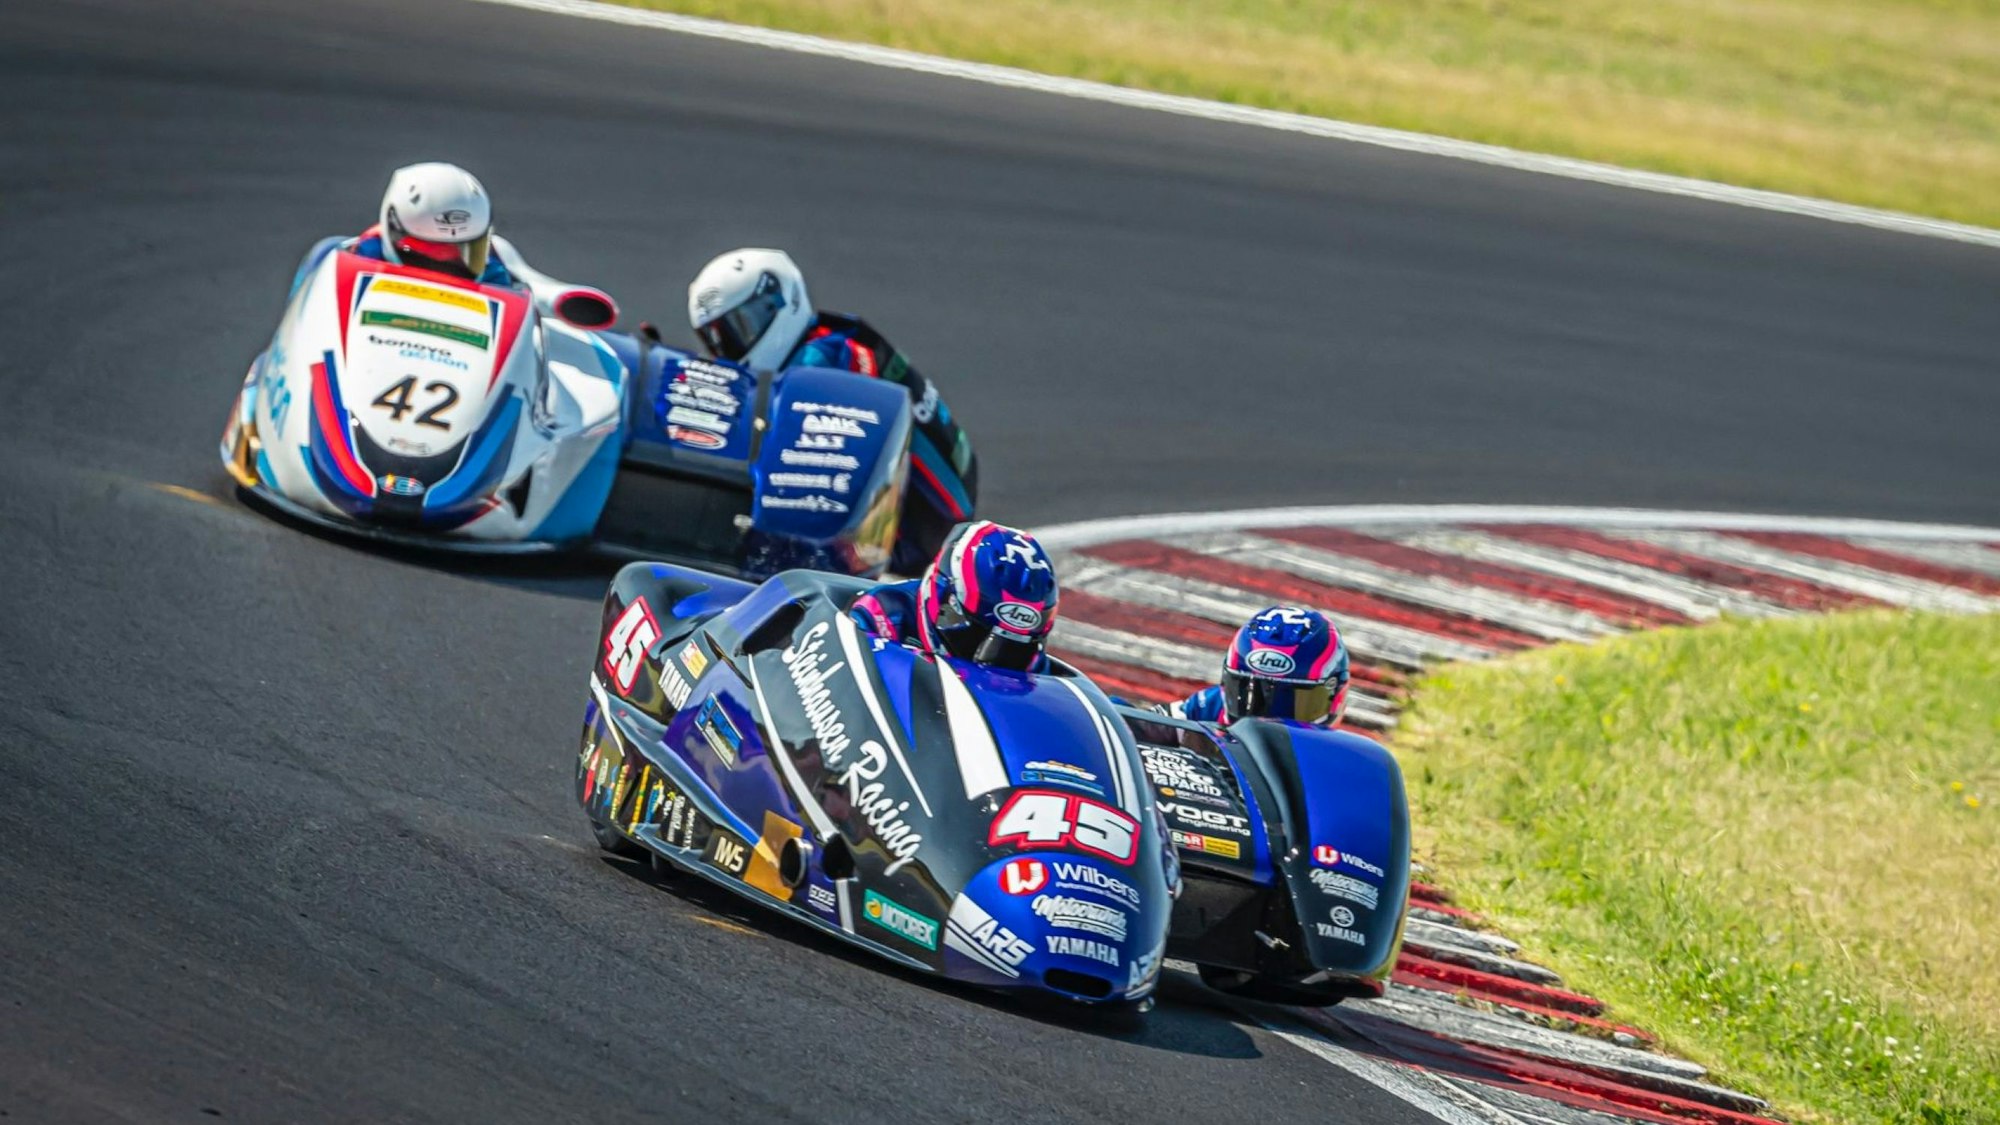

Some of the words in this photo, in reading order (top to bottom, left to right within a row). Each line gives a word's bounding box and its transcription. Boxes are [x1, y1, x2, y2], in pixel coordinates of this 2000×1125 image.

[371, 374, 460, 432] 42
[1005, 606, 1035, 624] Arai
[606, 599, 659, 692] 45
[1251, 652, 1288, 669] Arai
[782, 621, 851, 764] Steinhausen
[838, 740, 922, 877] Racing
[1168, 776, 1222, 797] PAGID
[996, 794, 1136, 861] 45
[1155, 800, 1249, 828] VOGT
[1177, 816, 1252, 837] engineering
[1340, 852, 1385, 878] Wilbers
[1052, 861, 1141, 905] Wilbers
[880, 901, 937, 946] MOTOREX
[1316, 922, 1366, 946] YAMAHA
[973, 919, 1036, 967] ARS
[1046, 935, 1120, 967] YAMAHA
